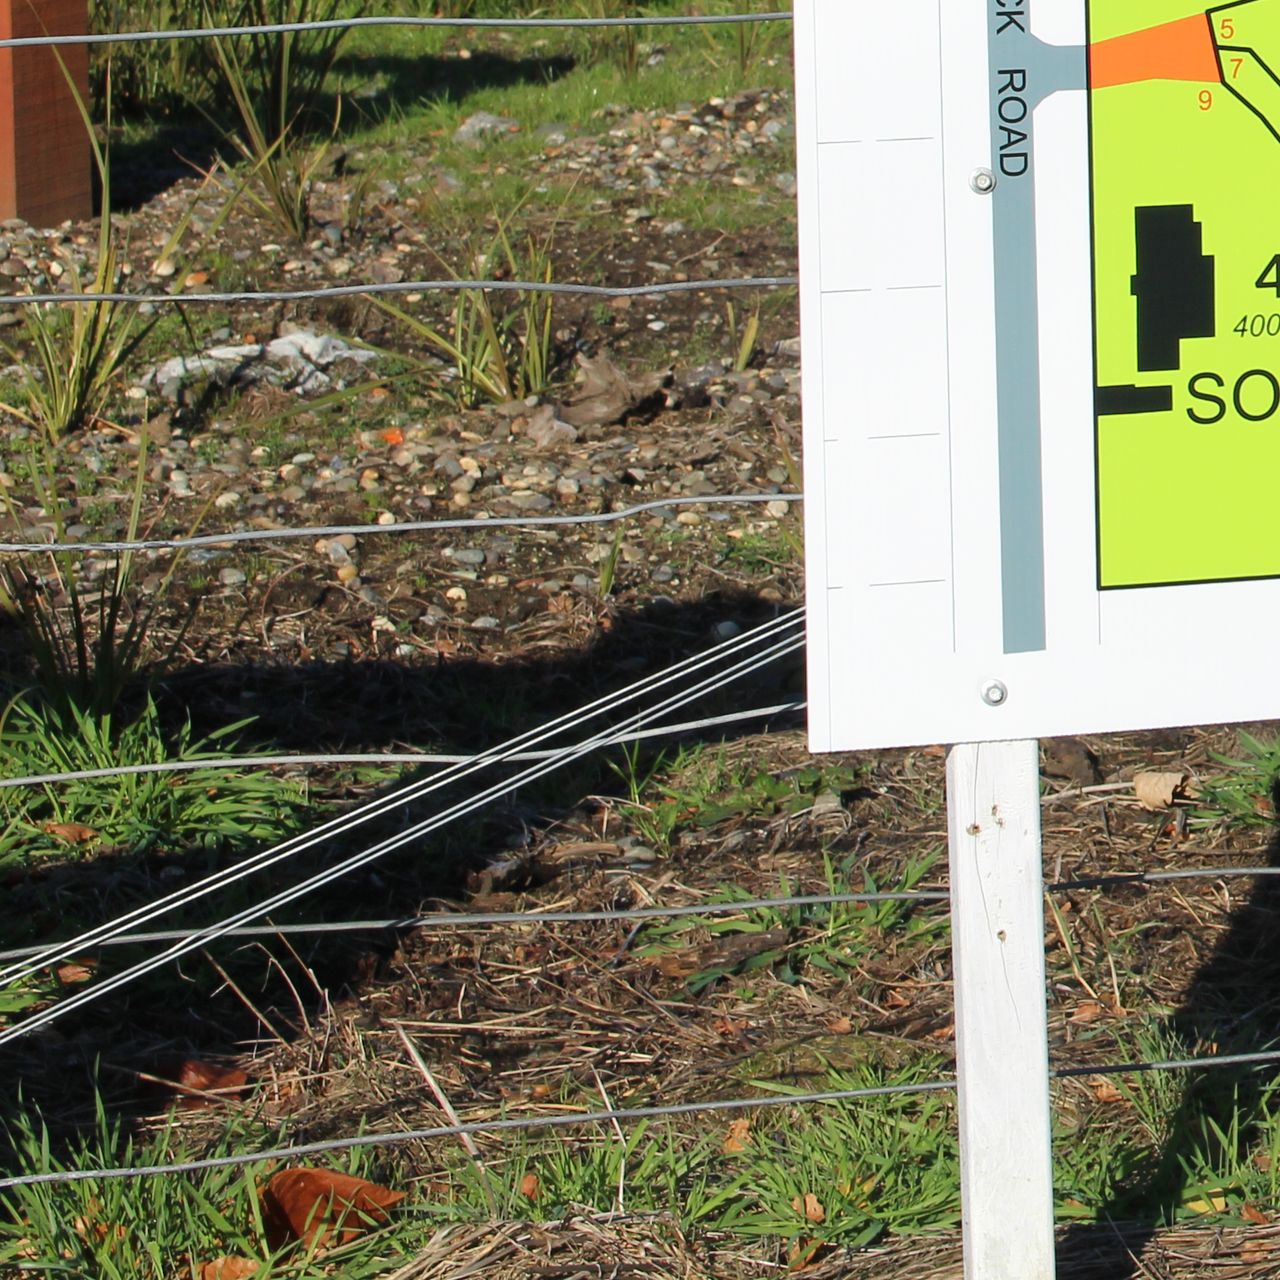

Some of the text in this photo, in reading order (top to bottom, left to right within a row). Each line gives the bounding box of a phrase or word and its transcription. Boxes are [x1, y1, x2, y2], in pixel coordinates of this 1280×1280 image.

[1219, 19, 1234, 39] 5
[1230, 58, 1243, 78] 7
[1198, 89, 1213, 110] 9
[996, 69, 1028, 177] ROAD
